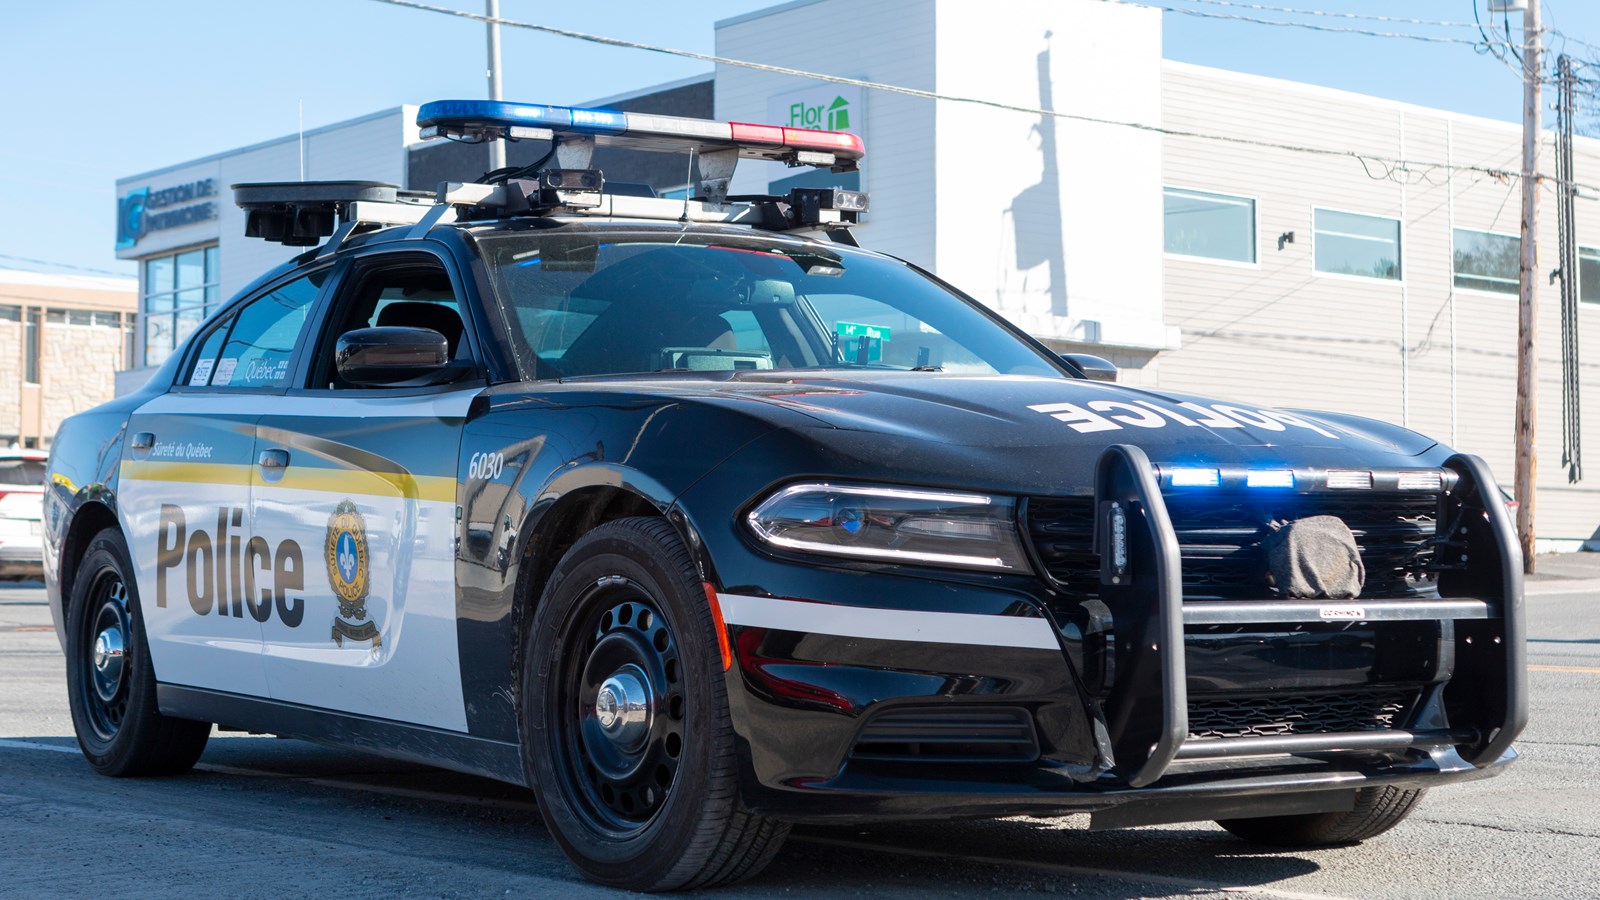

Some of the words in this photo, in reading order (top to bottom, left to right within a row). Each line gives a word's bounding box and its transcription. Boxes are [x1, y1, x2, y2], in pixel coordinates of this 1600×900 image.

[790, 101, 825, 127] Flor
[245, 360, 277, 383] Québec
[175, 442, 186, 457] du
[186, 441, 213, 460] Québec
[469, 452, 504, 480] 6030
[156, 503, 305, 628] Police
[338, 579, 361, 599] POLICE
